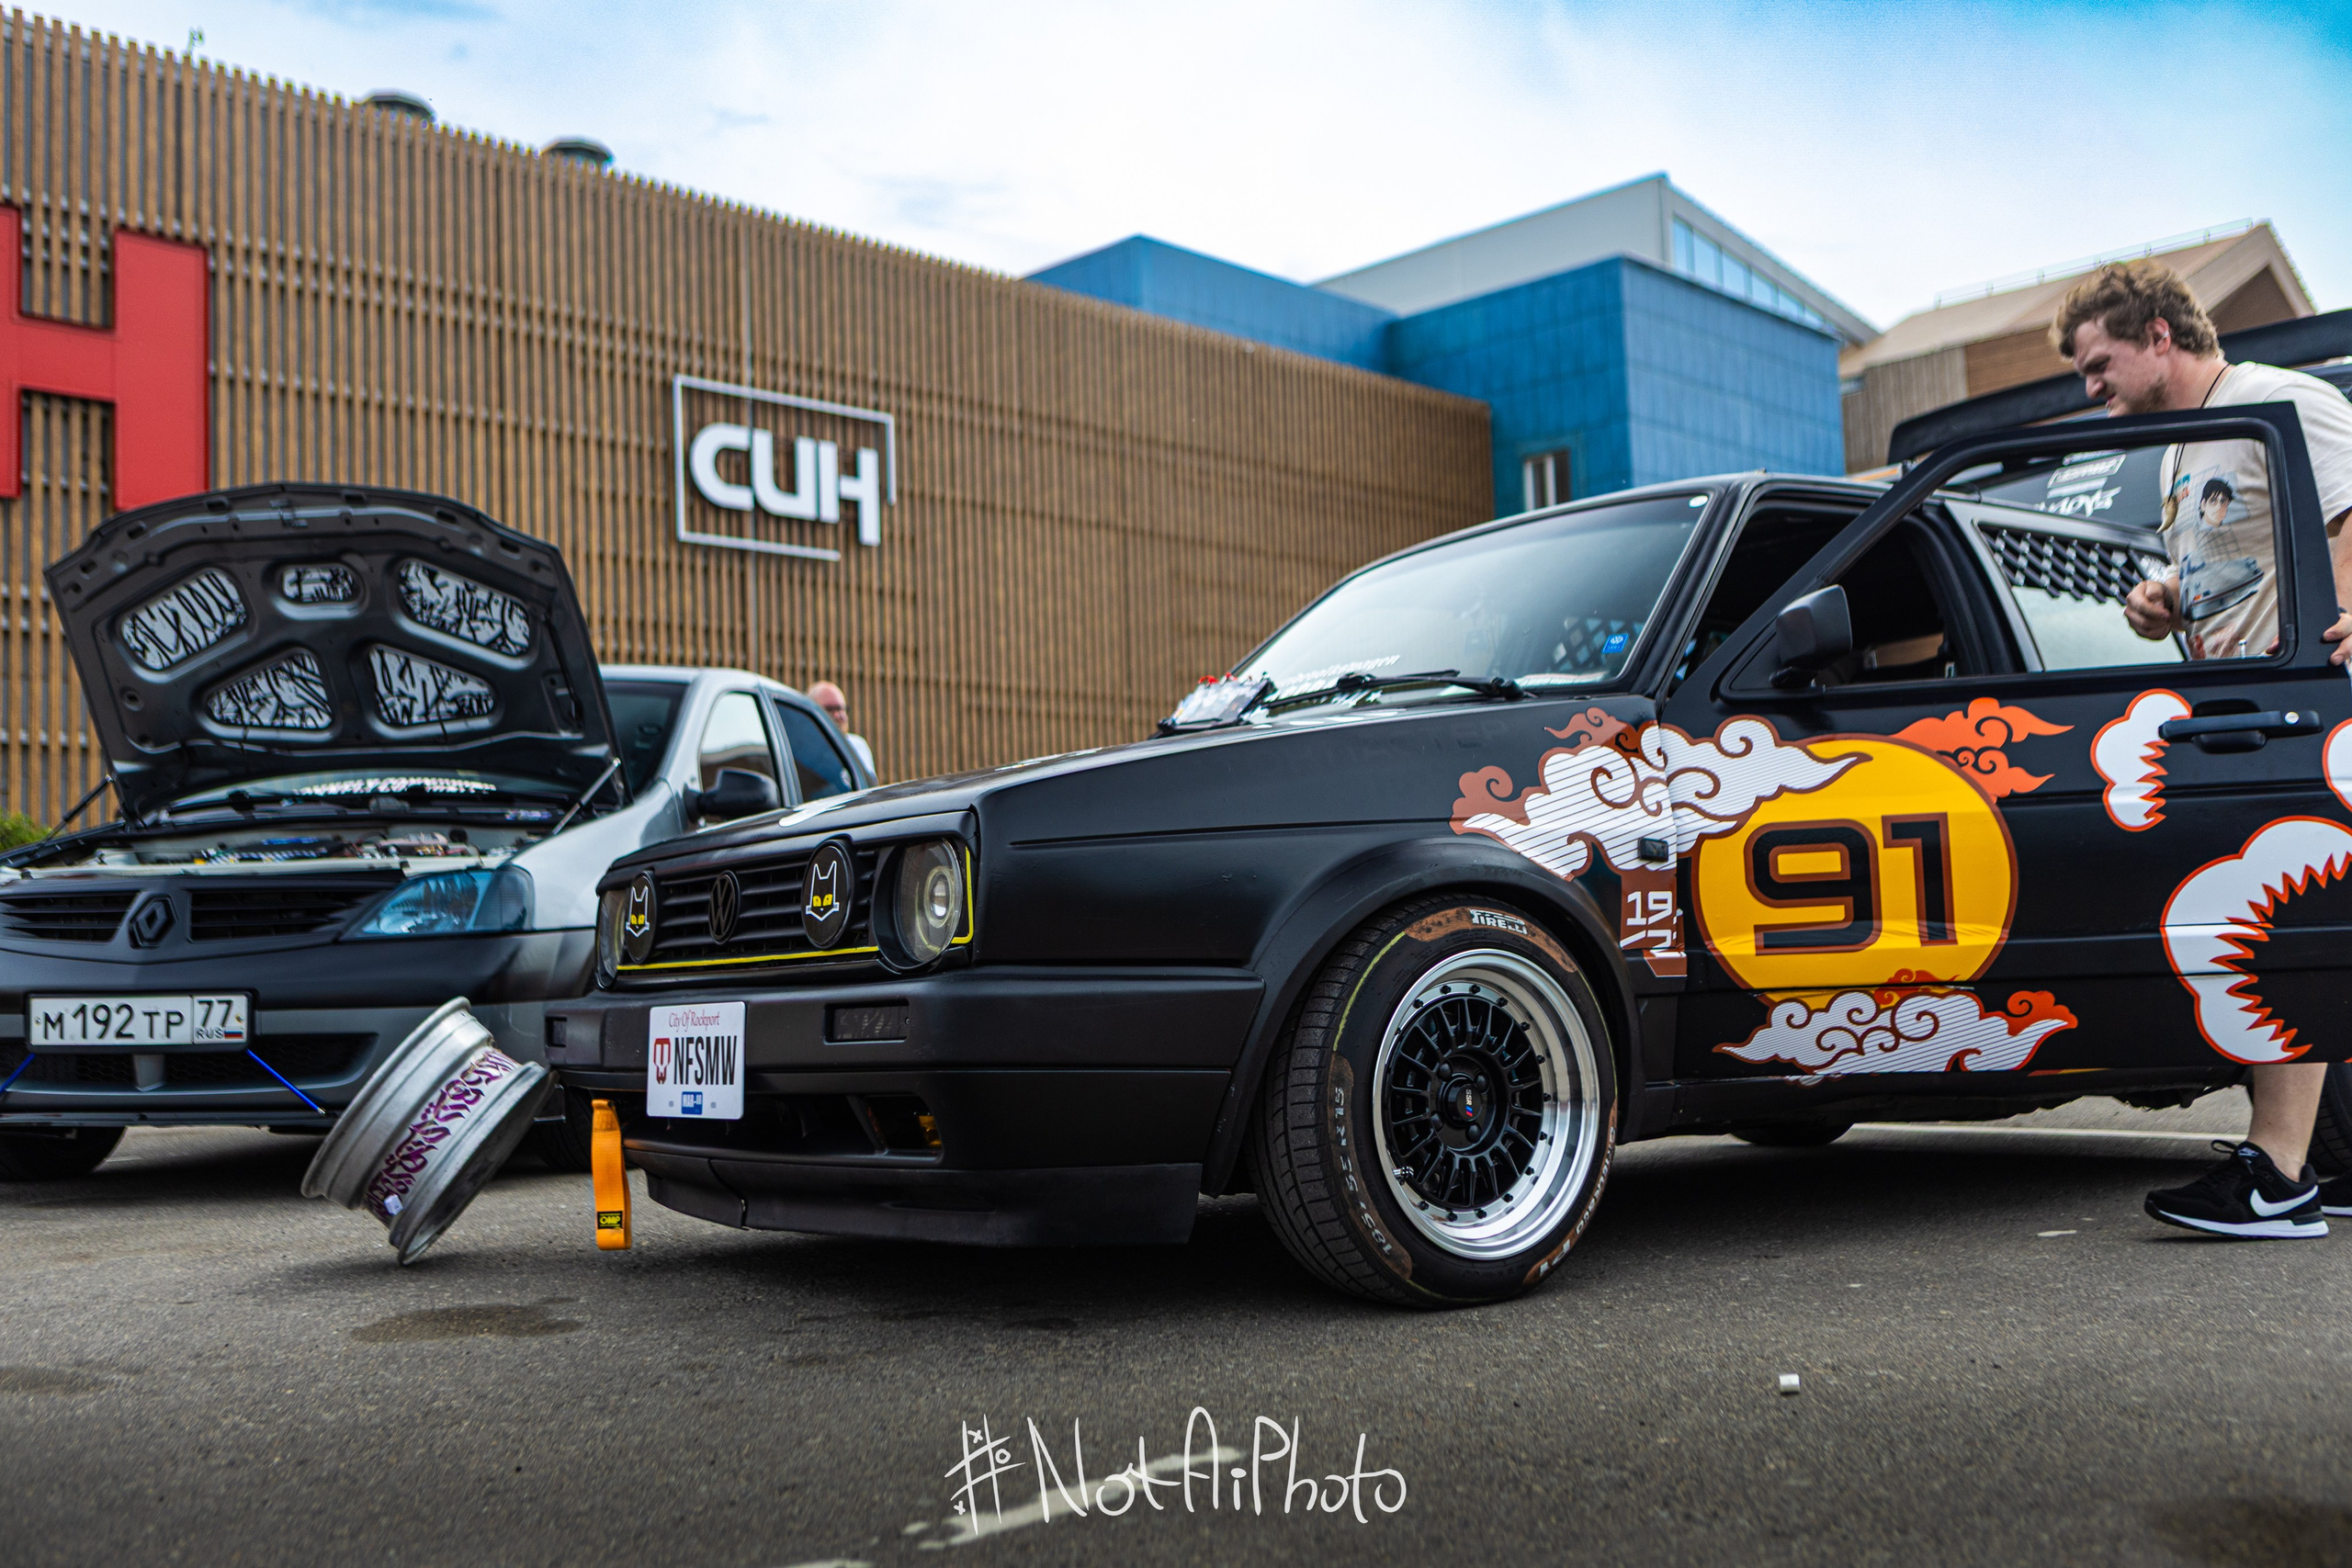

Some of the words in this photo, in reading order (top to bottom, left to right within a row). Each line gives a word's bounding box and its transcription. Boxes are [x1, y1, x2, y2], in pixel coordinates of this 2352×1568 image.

[1744, 812, 1958, 955] 91
[1470, 908, 1528, 935] PIRELLI
[198, 999, 233, 1028] 77
[668, 1012, 681, 1032] City
[689, 1009, 720, 1032] Rockport
[195, 1027, 224, 1041] RUS
[673, 1035, 737, 1086] NFSMW
[599, 1214, 621, 1225] OMP
